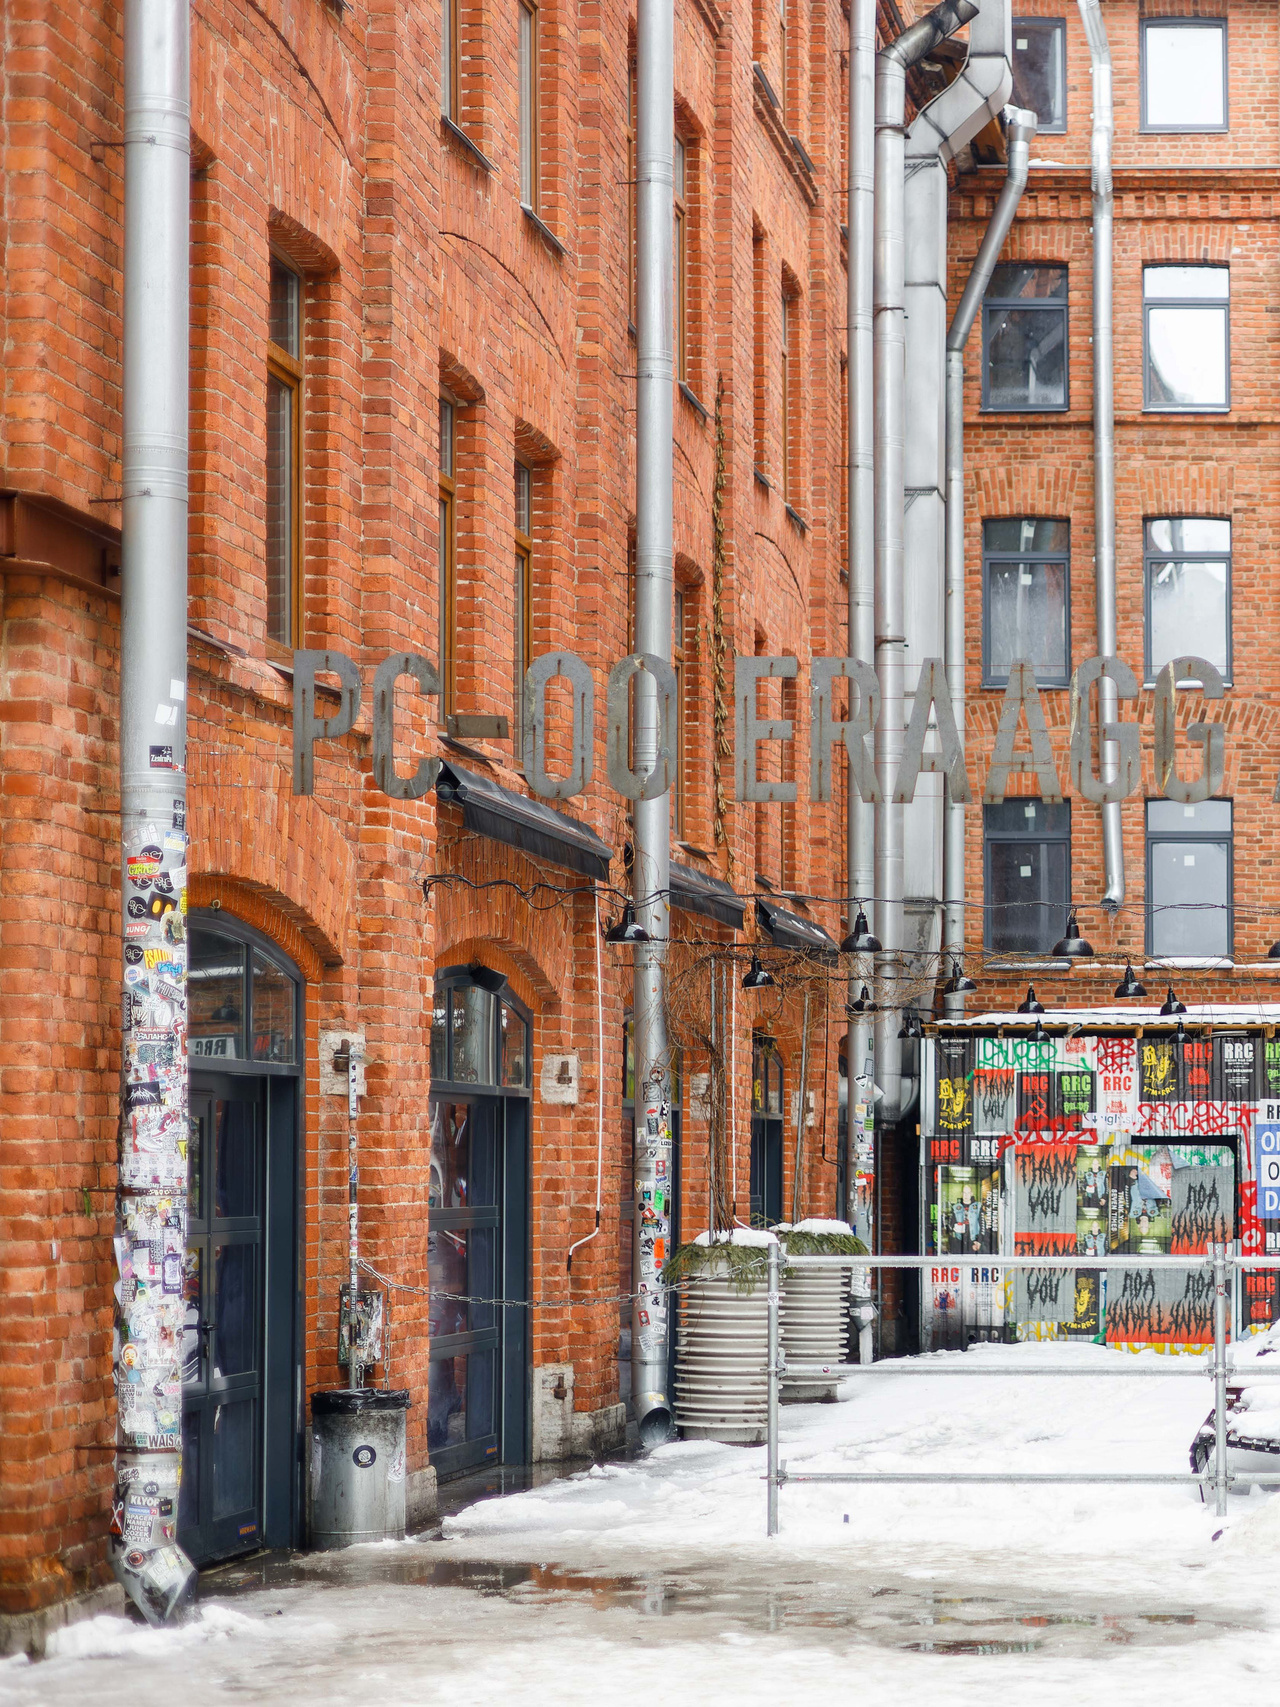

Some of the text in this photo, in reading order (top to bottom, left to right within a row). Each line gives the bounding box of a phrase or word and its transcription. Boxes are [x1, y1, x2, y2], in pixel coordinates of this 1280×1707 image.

[734, 655, 1227, 804] ERAAGG
[1184, 1043, 1213, 1058] RRC
[1225, 1043, 1254, 1058] RRC
[1022, 1076, 1049, 1091] RRC
[1061, 1075, 1092, 1091] RRC
[1103, 1076, 1132, 1091] RRC
[930, 1140, 960, 1156] RRC
[931, 1267, 960, 1282] RRC
[971, 1267, 999, 1282] RRC
[1246, 1276, 1276, 1292] RRC
